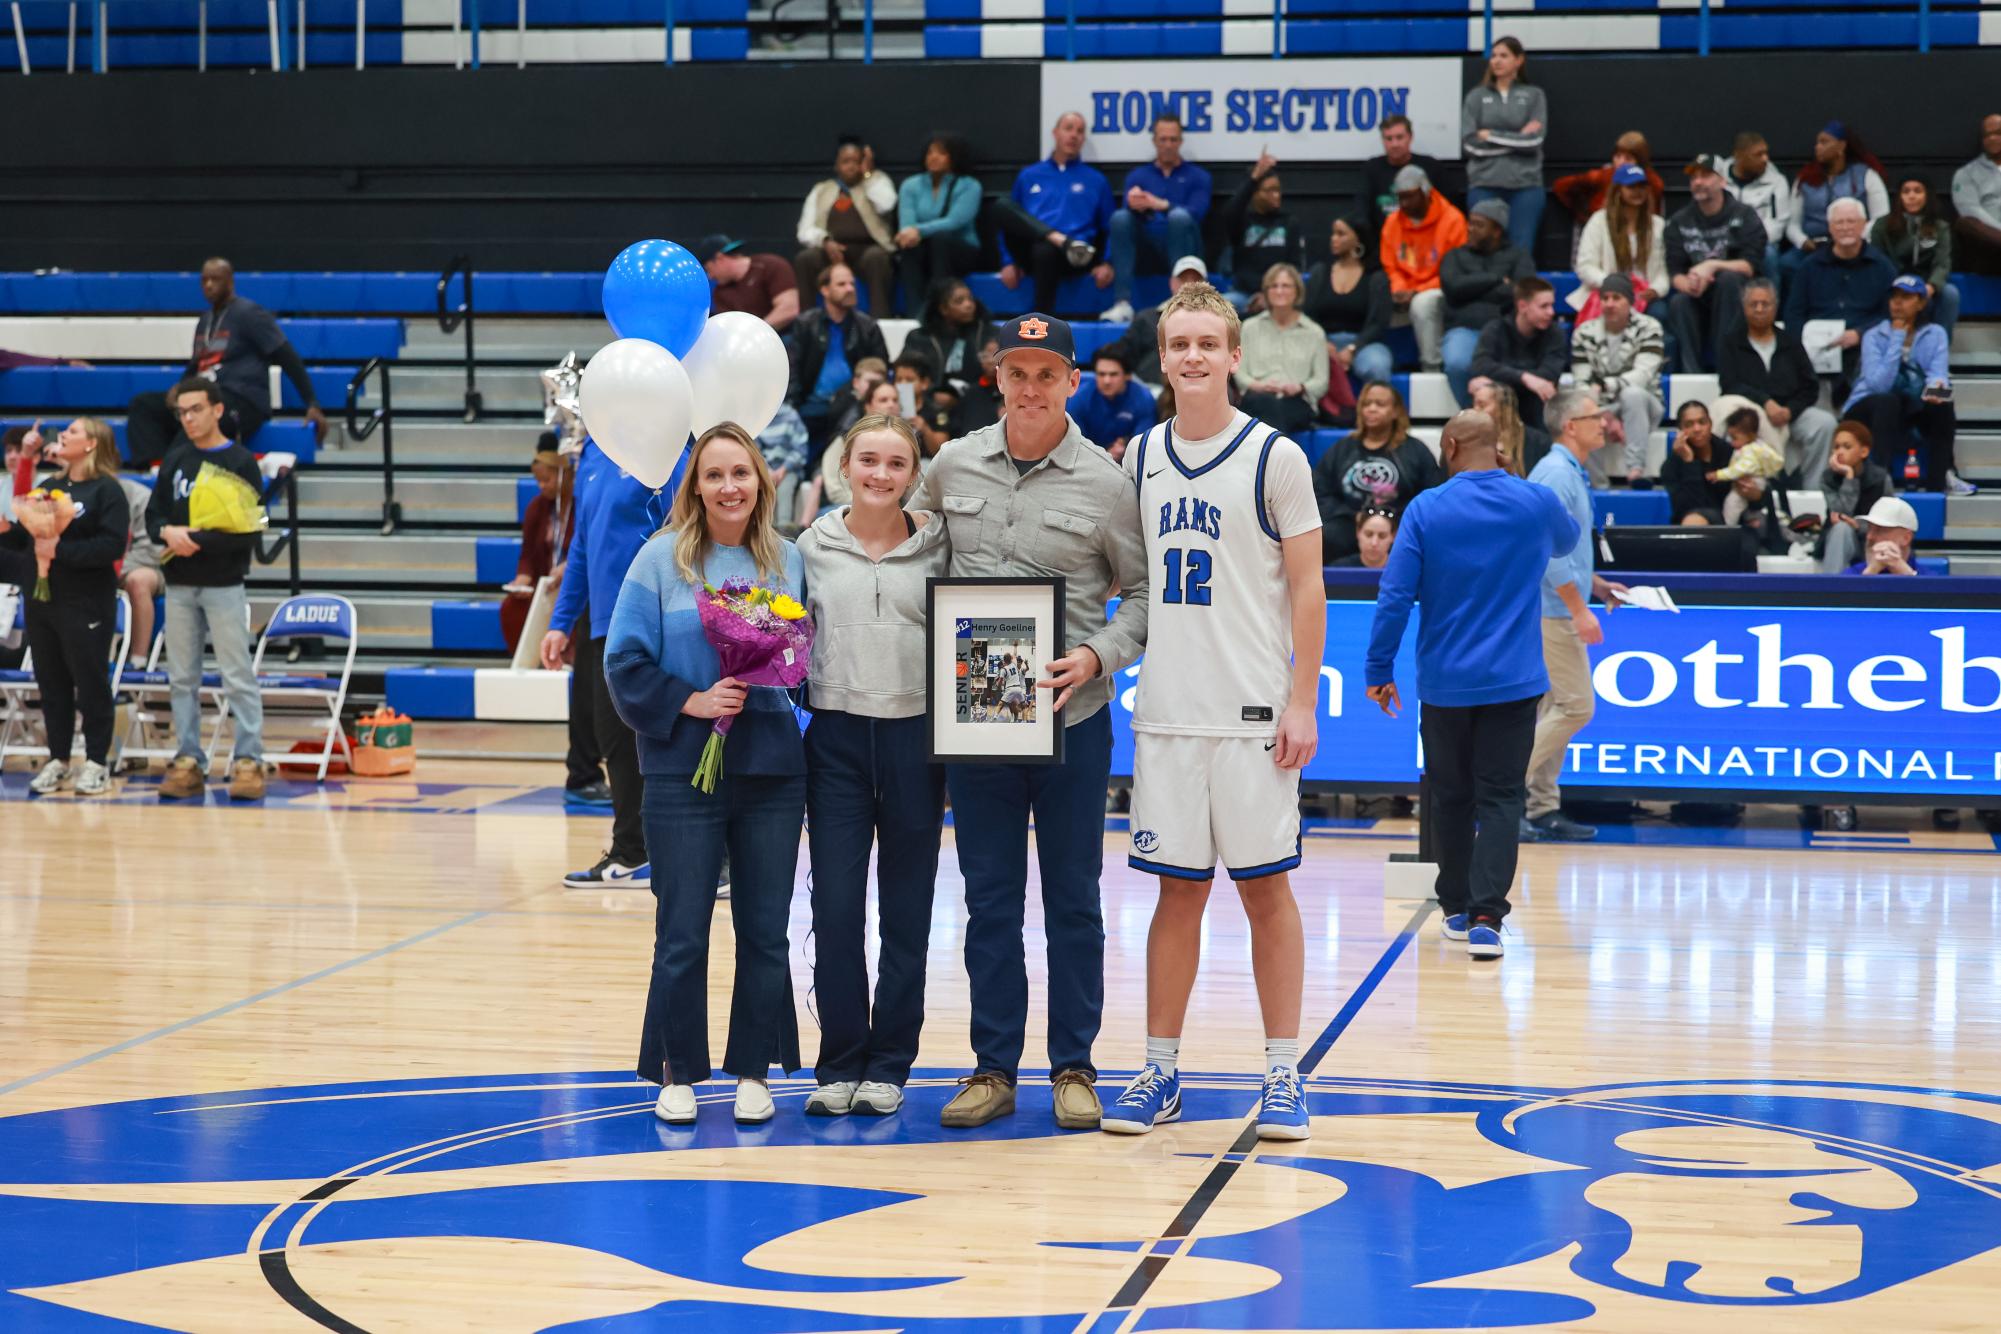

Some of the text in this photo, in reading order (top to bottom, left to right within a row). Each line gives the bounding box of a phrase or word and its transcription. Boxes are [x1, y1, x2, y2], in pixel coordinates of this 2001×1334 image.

[1091, 87, 1409, 133] HOME SECTION
[1158, 497, 1222, 541] RAMS
[1163, 548, 1212, 606] 12
[285, 605, 340, 623] LADUE
[972, 624, 997, 634] Henry
[1592, 623, 2001, 713] otheb
[1567, 743, 1973, 781] TERNATIONAL
